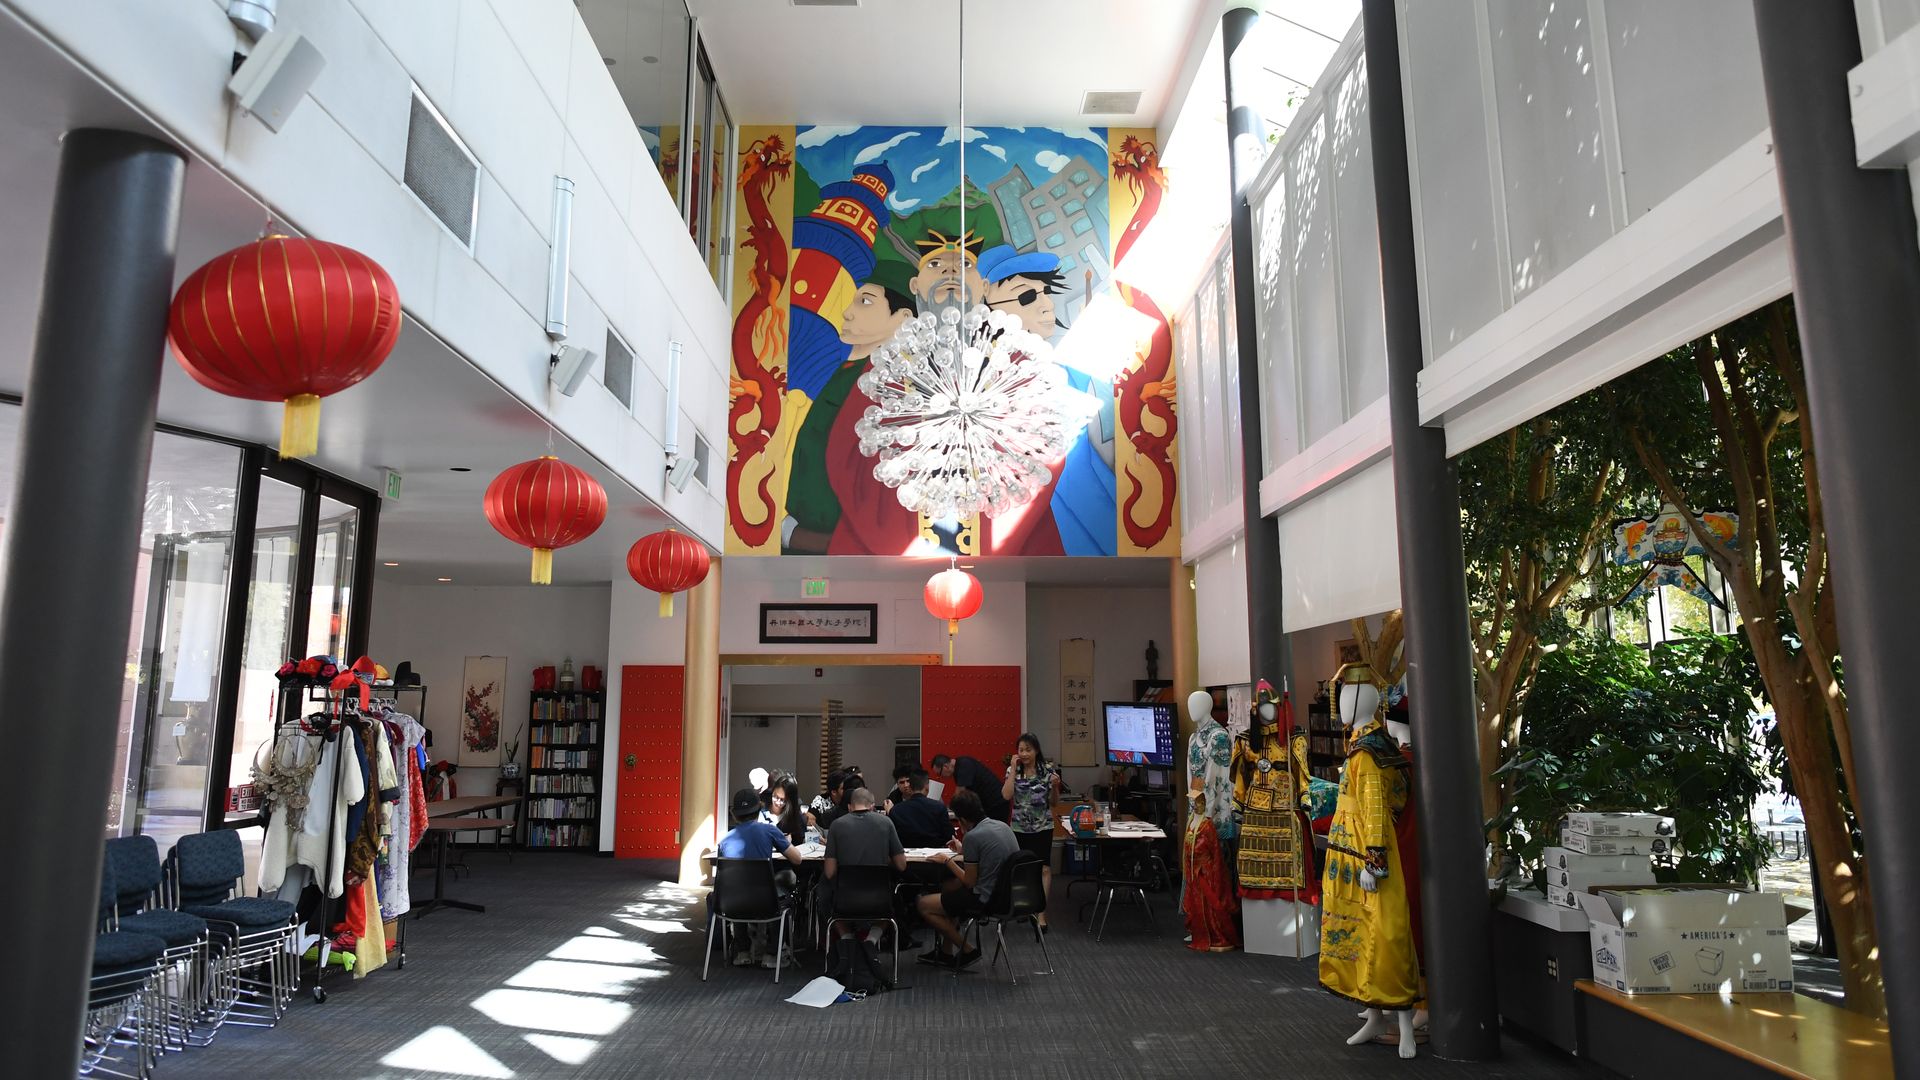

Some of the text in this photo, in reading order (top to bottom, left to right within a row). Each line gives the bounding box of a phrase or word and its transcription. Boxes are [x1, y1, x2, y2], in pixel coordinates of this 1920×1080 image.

[388, 473, 401, 499] EXIT
[806, 581, 826, 595] EXIT
[1690, 931, 1728, 940] AMERICA'S
